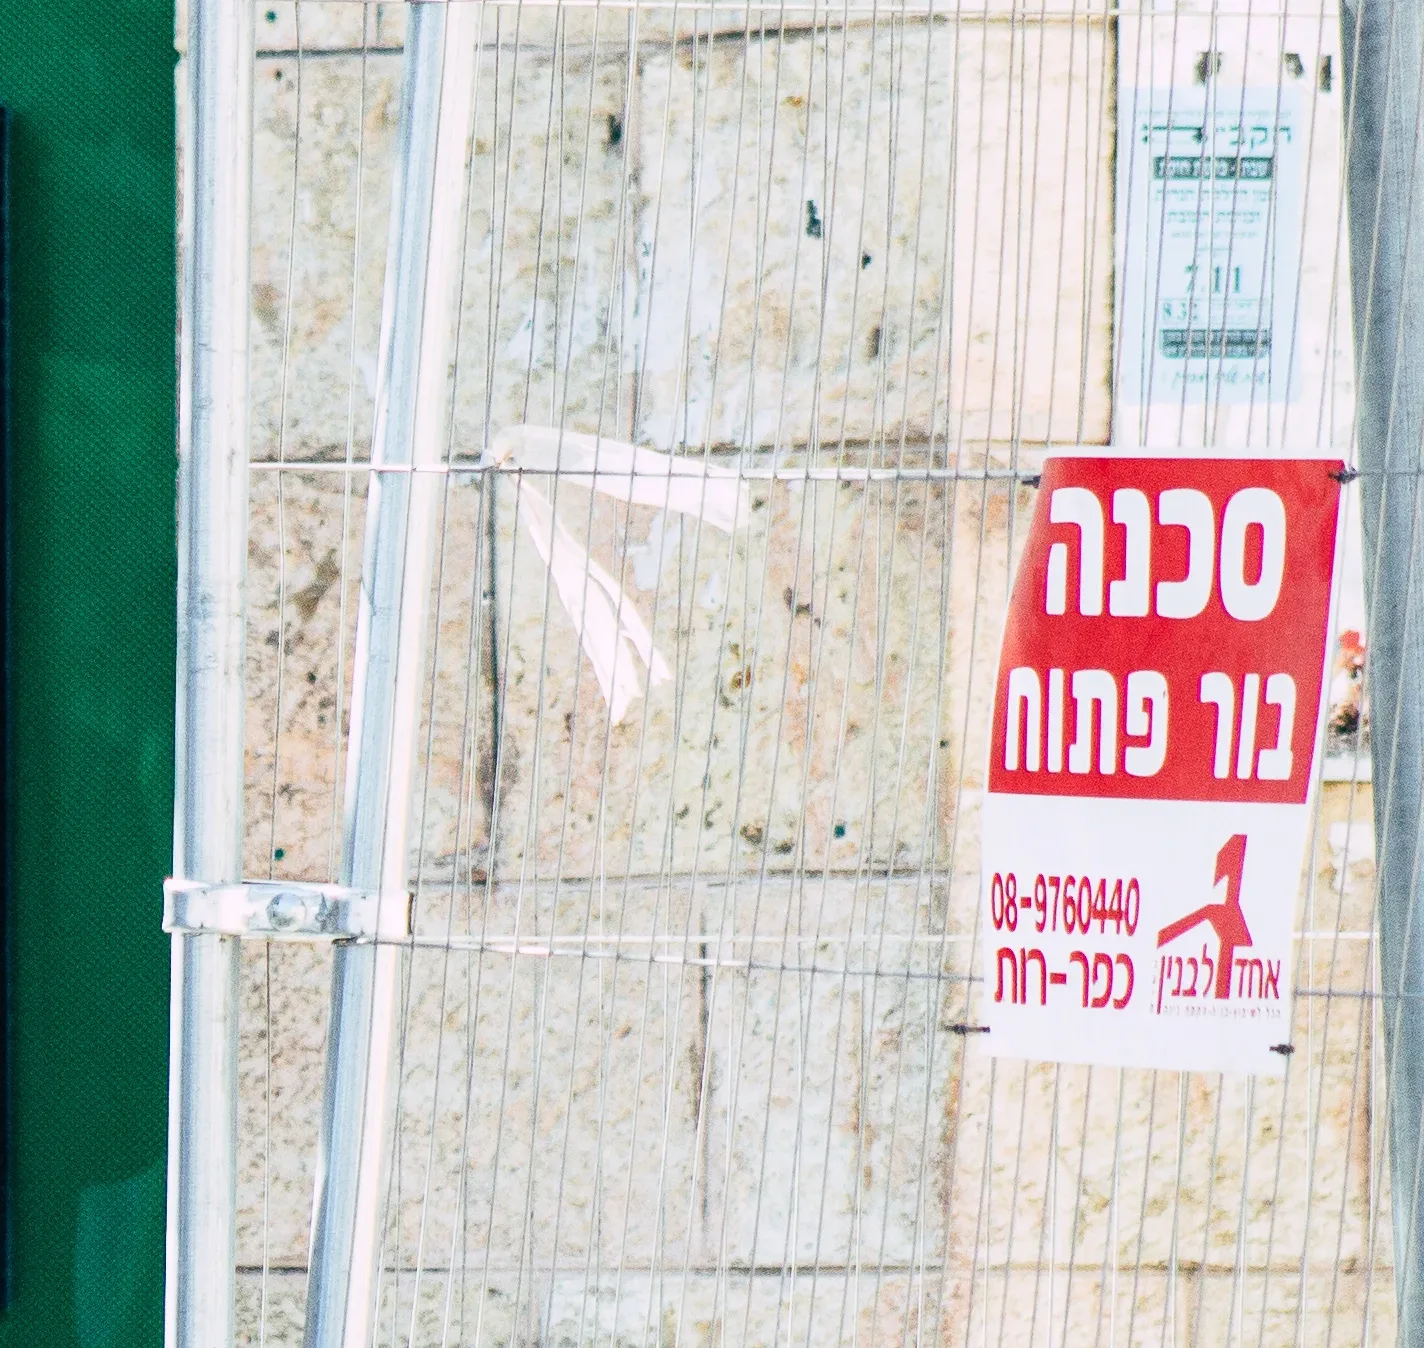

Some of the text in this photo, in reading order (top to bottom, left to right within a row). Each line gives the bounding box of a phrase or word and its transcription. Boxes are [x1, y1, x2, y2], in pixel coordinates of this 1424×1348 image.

[1045, 487, 1288, 622] סכנה
[1004, 666, 1297, 781] בור פתוח
[990, 872, 1141, 937] 08-9760440
[994, 946, 1136, 1011] כפר-רות
[1156, 942, 1215, 1015] לבנין
[1235, 958, 1281, 1000] אחד
